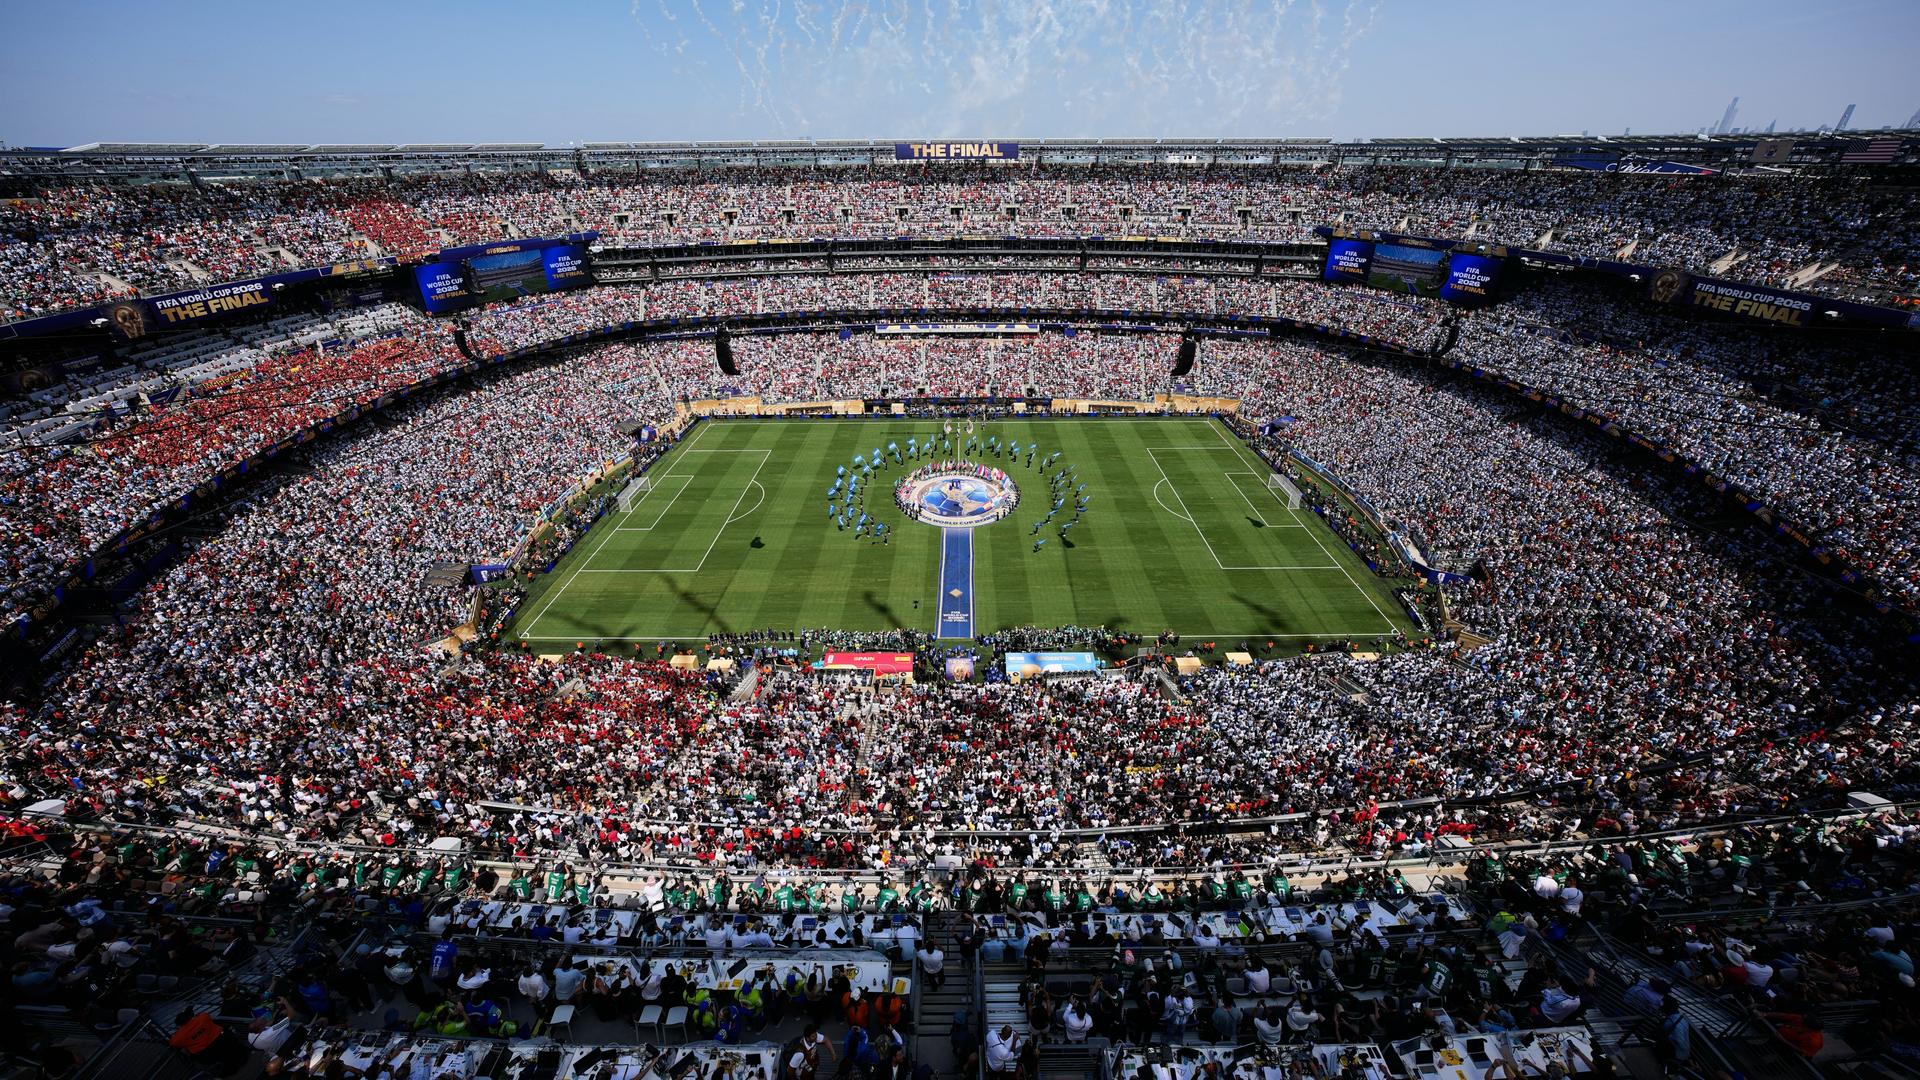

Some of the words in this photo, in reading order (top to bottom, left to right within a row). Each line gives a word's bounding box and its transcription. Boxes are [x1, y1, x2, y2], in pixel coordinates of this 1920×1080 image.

[910, 144, 946, 158] THE
[950, 144, 1004, 158] FINAL
[550, 261, 570, 269] WORLD
[1453, 272, 1475, 280] WORLD
[426, 279, 450, 289] WORLD
[451, 277, 464, 286] CUP
[1458, 279, 1480, 287] 2026
[436, 285, 459, 294] 2026
[1465, 286, 1486, 294] FINAL
[156, 299, 179, 310] FIFA
[179, 291, 213, 305] WORLD
[213, 288, 231, 298] CUP
[232, 283, 263, 295] 2026
[431, 293, 447, 301] THE
[447, 290, 468, 298] FINAL
[1696, 283, 1716, 293] FIFA
[1717, 286, 1751, 299] WORLD
[1752, 293, 1774, 303] CUP
[1774, 297, 1812, 311] 2026
[160, 303, 208, 323] THE
[208, 291, 269, 313] FINAL
[1694, 290, 1733, 313] THE
[1734, 300, 1801, 326] FINAL
